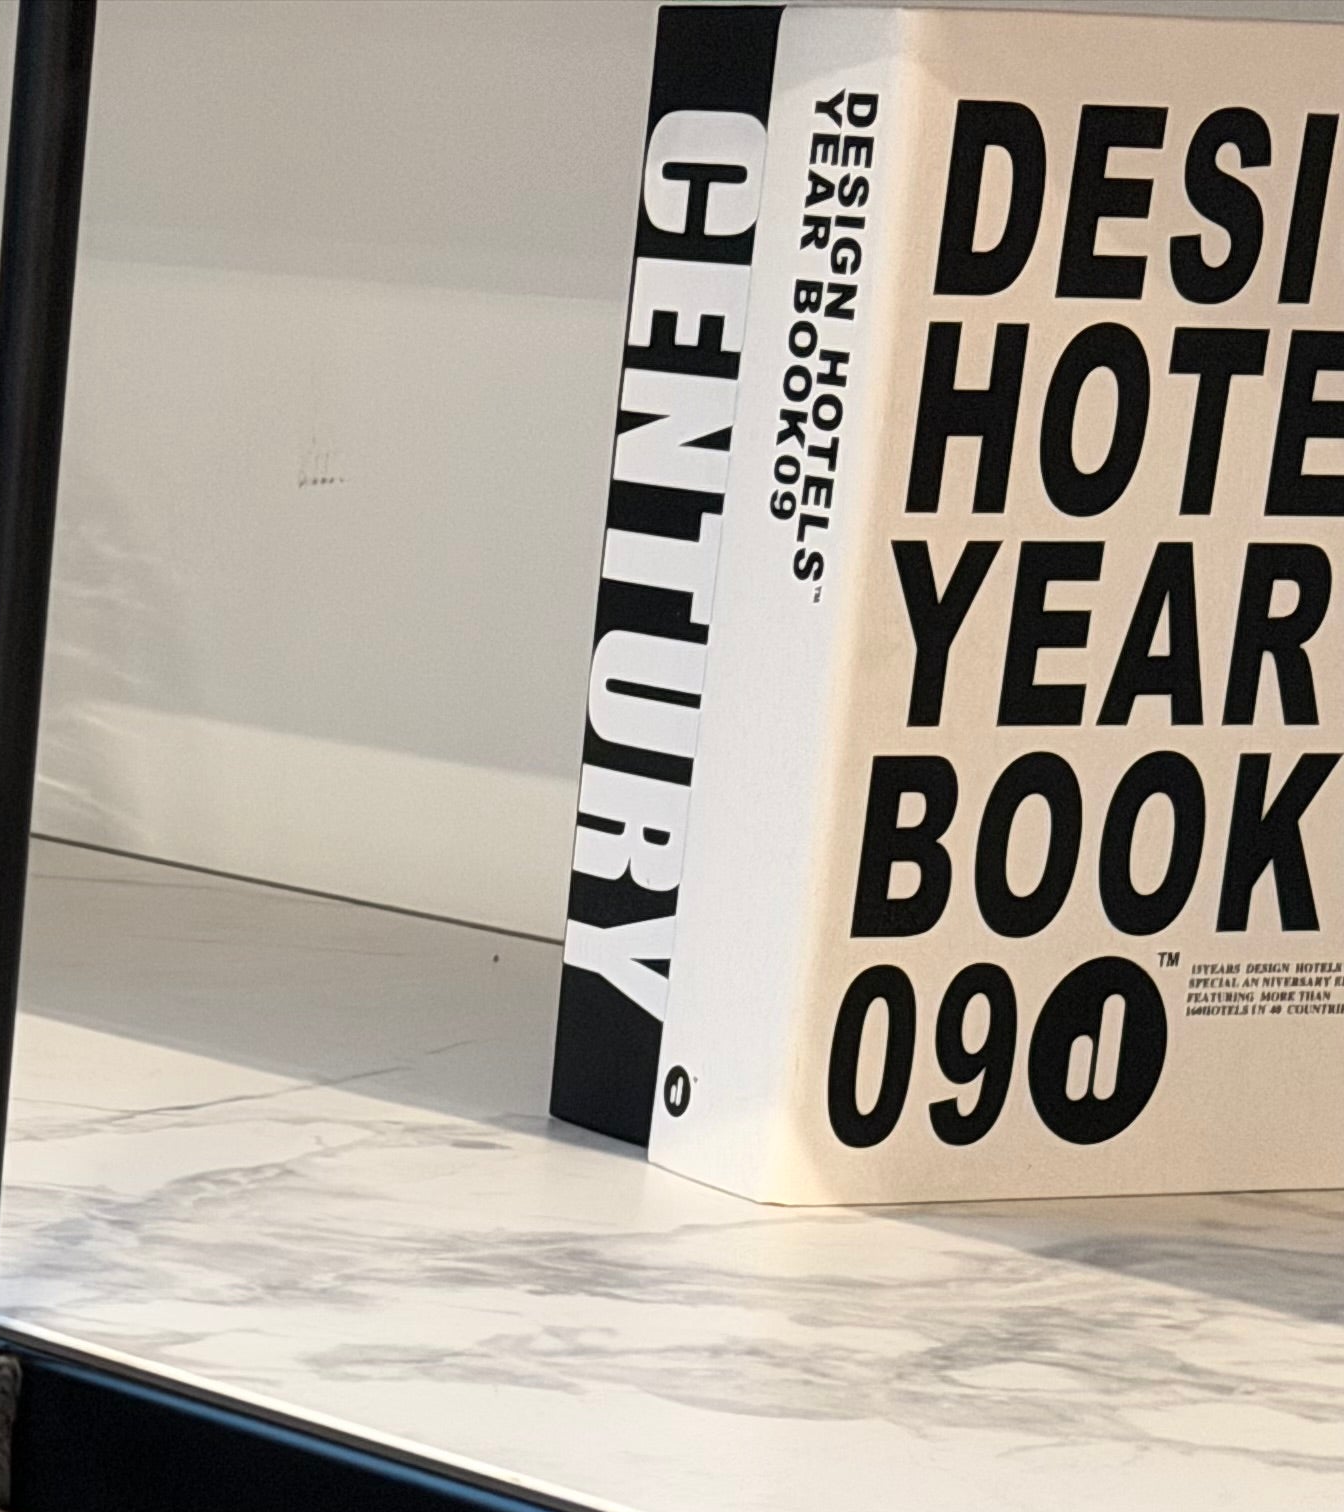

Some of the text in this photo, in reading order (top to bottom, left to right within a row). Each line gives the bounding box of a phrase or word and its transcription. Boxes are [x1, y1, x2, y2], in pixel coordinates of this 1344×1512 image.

[799, 88, 846, 250] YEAR
[823, 92, 879, 321] DESIGN
[934, 100, 1340, 304] DESI
[905, 322, 1344, 519] HOTE
[564, 110, 767, 1023] CENTURY
[891, 540, 1332, 727] YEAR
[850, 750, 1344, 938] BOOK
[1187, 990, 1331, 1003] FEATURING MORE THAN
[1189, 977, 1239, 988] SPECIAL
[1245, 963, 1290, 974] DESIGN
[1296, 962, 1342, 974] HOTELS
